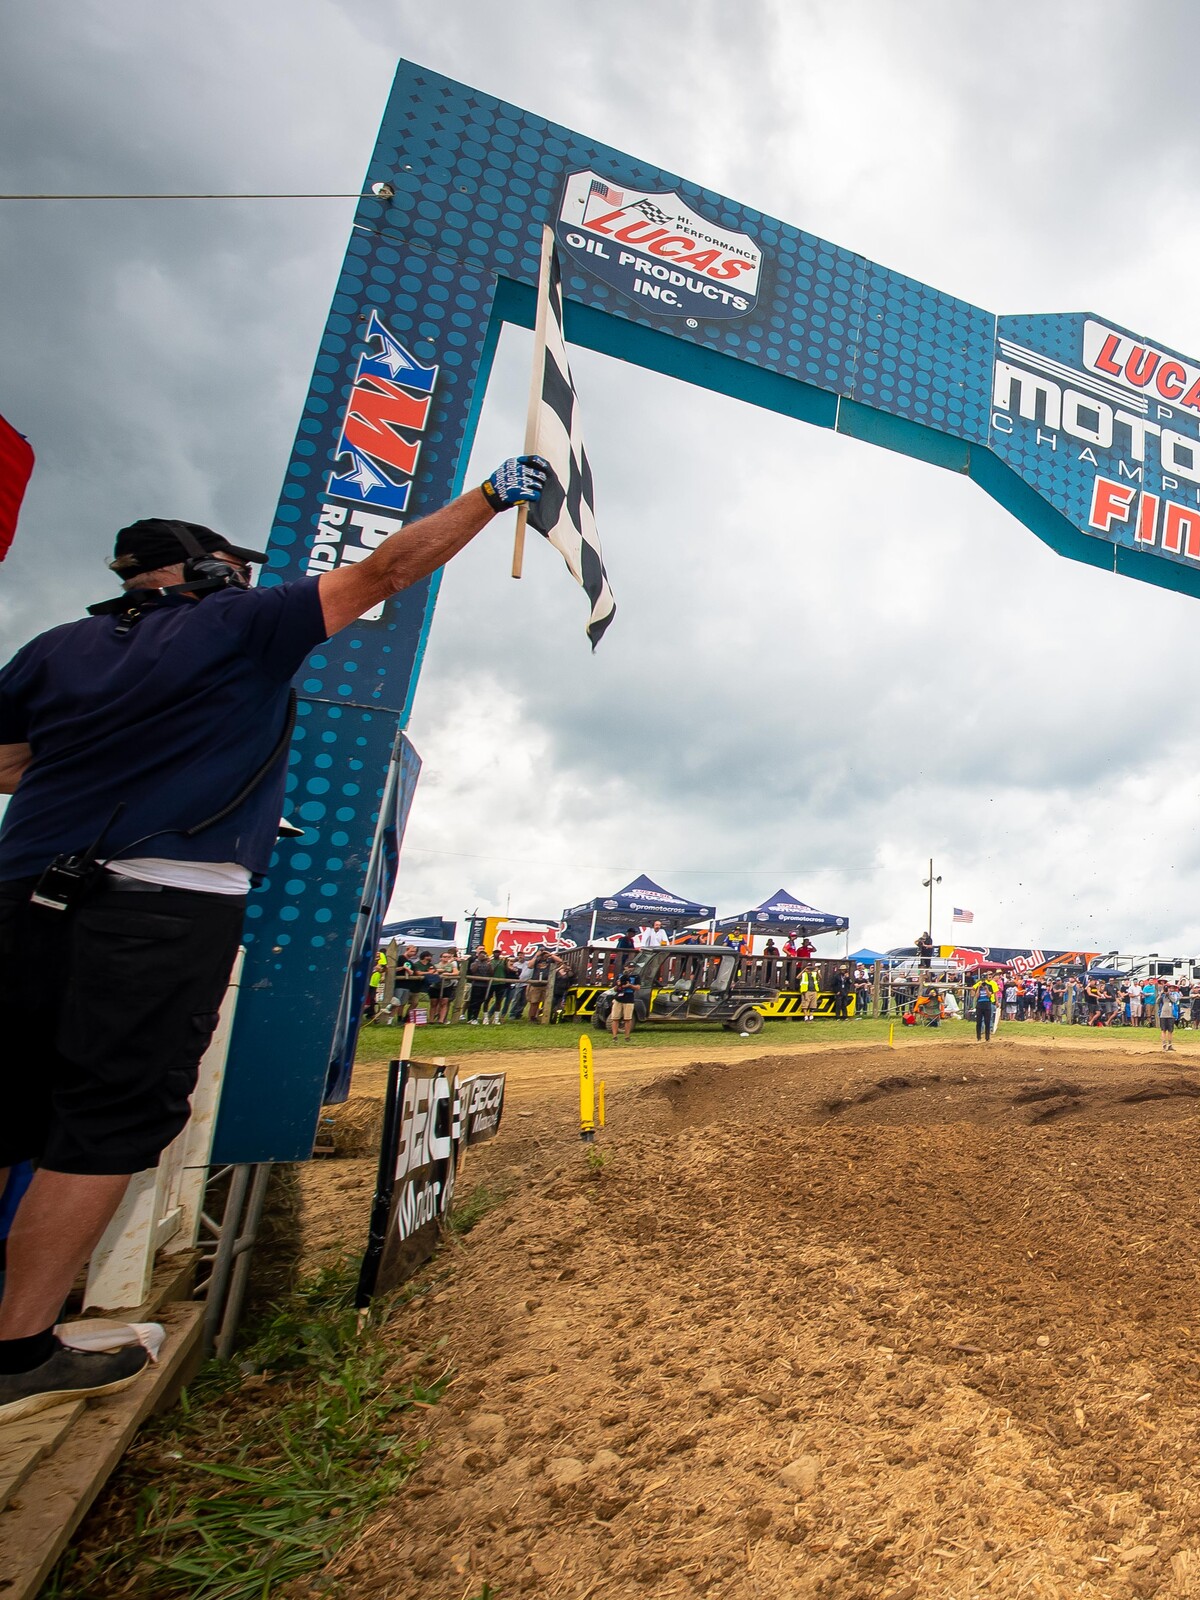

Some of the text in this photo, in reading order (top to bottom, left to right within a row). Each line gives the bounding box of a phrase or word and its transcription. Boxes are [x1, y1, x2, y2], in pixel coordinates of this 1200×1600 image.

[677, 215, 693, 226] HI-
[582, 210, 752, 280] LUCAS
[676, 224, 757, 261] PERFORMANCE
[565, 233, 750, 311] OIL PRODUCTS
[633, 278, 683, 308] INC.
[326, 309, 439, 512] AMA
[629, 902, 686, 914] @promotocross
[1013, 948, 1046, 974] Bull
[395, 1077, 452, 1182] GEIC
